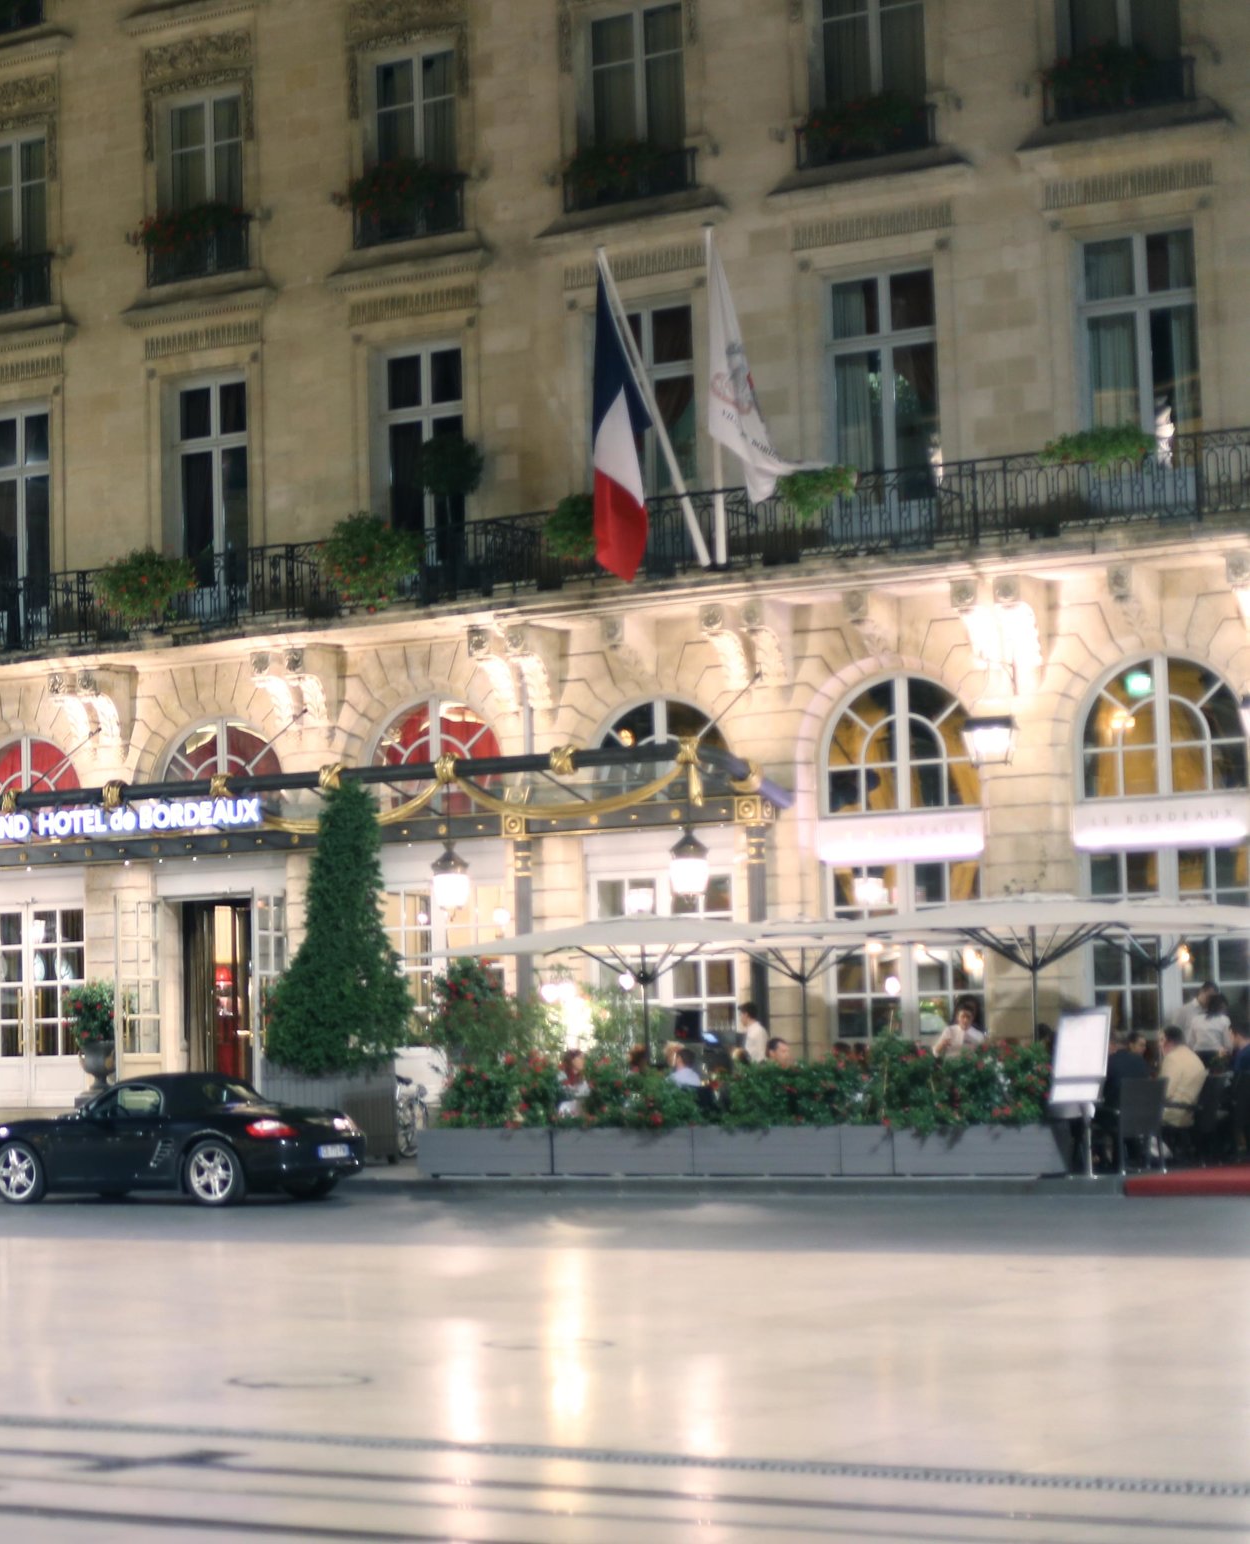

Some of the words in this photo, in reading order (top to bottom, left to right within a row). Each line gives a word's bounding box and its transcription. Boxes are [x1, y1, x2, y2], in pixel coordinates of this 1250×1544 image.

[38, 809, 107, 836] HOTEL
[110, 807, 136, 831] de
[139, 798, 259, 830] BORDEAUX
[1126, 807, 1233, 825] BORDEAUX
